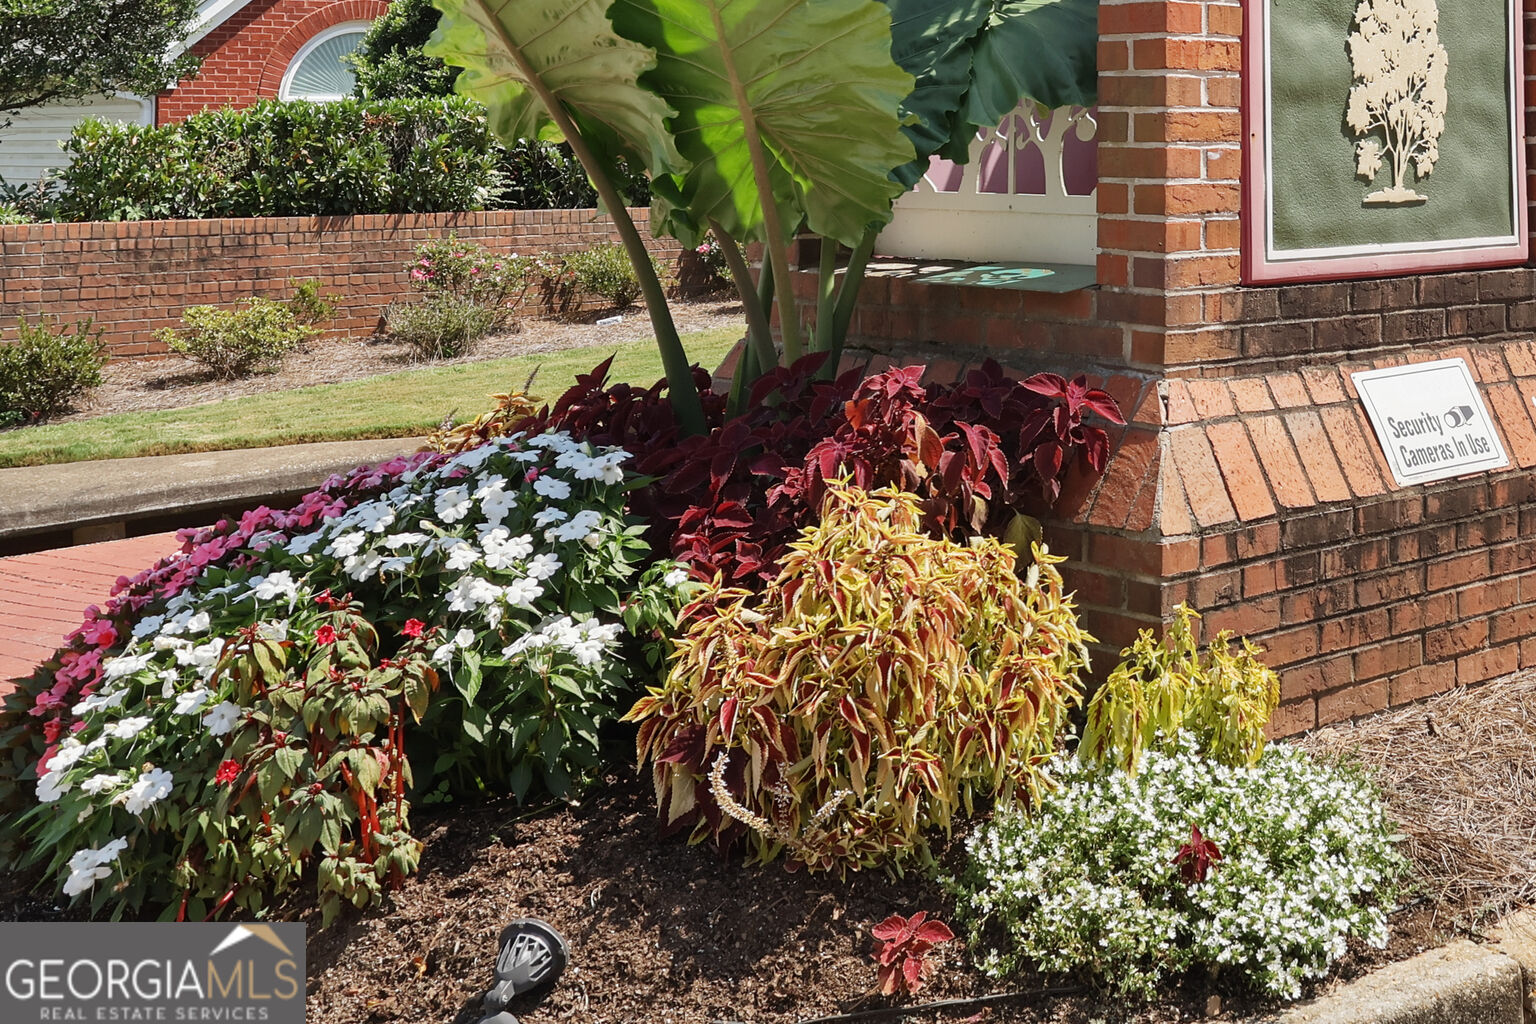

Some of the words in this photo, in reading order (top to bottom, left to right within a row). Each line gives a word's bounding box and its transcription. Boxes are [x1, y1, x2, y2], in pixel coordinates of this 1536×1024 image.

[1387, 411, 1444, 439] Security
[1399, 441, 1455, 468] Cameras
[1452, 436, 1468, 458] In
[1464, 433, 1491, 456] Use
